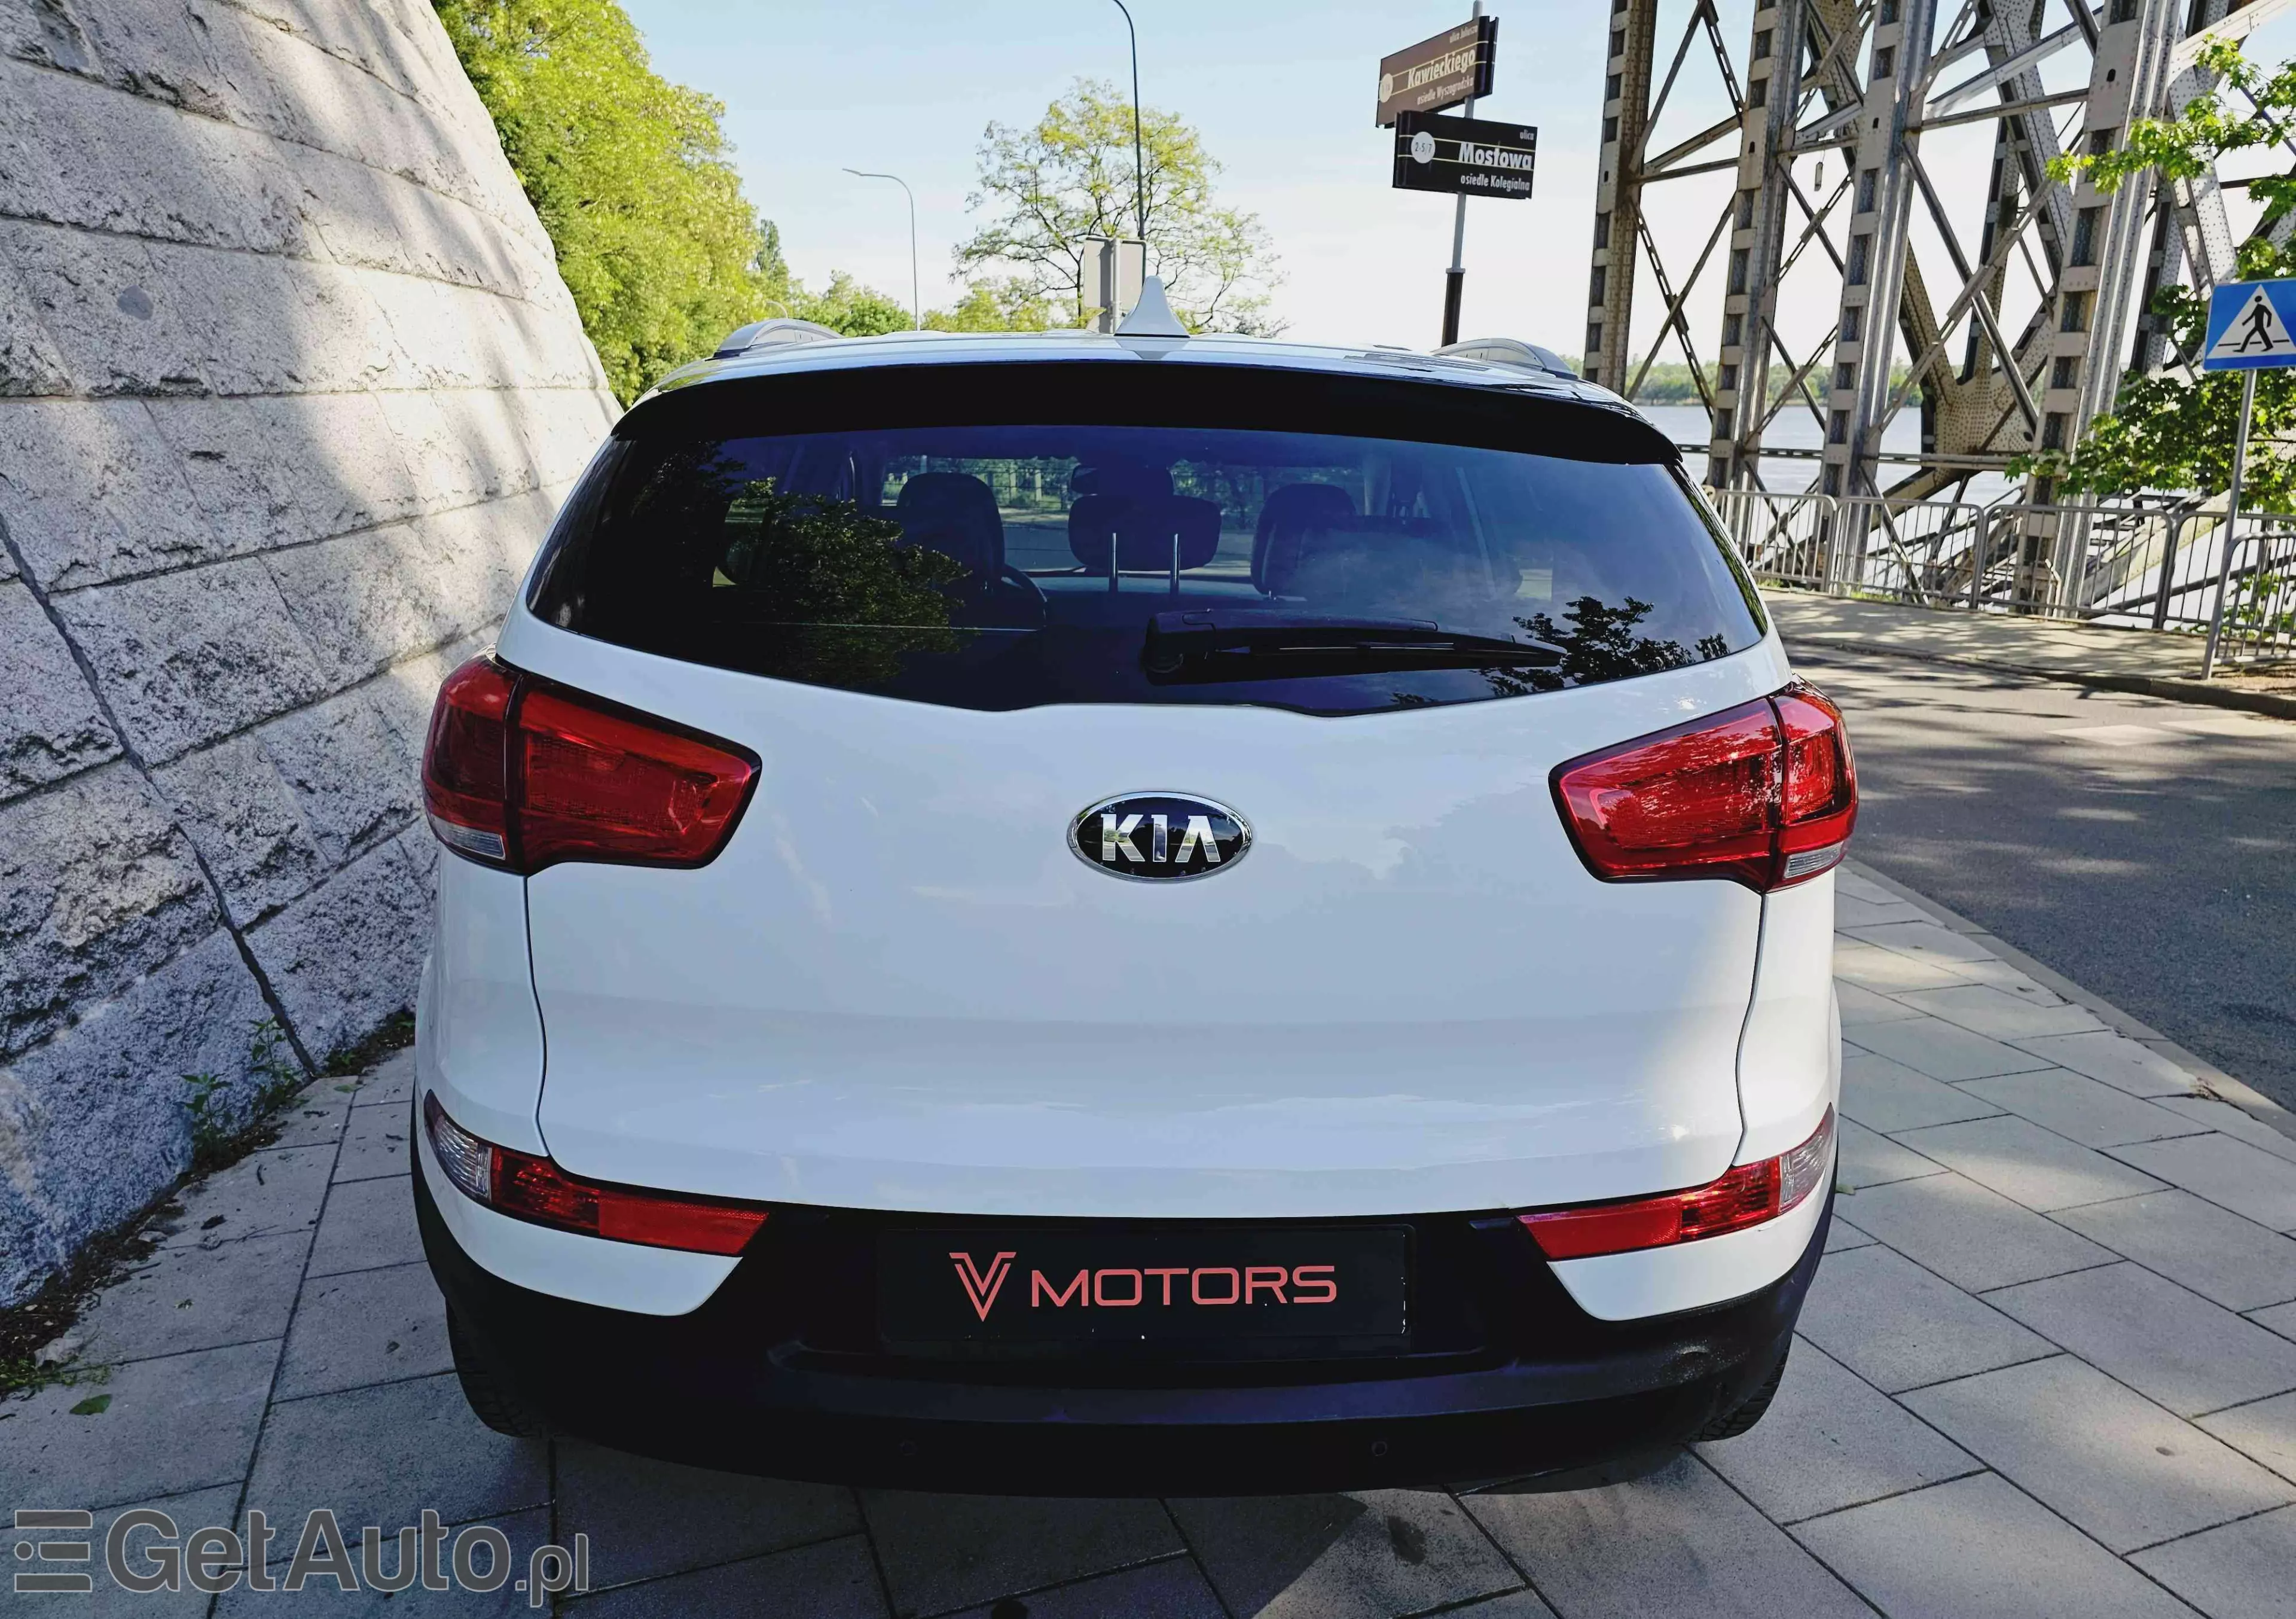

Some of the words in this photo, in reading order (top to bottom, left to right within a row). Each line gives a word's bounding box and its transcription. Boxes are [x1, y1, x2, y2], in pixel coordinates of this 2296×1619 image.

[1407, 49, 1476, 89] Kawieckiego
[1417, 89, 1436, 105] osiedle
[1519, 129, 1534, 141] ulica
[1458, 142, 1532, 171] Mostowa
[1460, 173, 1489, 187] osiedle
[1491, 174, 1531, 192] Kolegialna
[1101, 813, 1220, 862] KIA
[949, 1251, 1017, 1322] V
[1031, 1265, 1337, 1307] MOTORS
